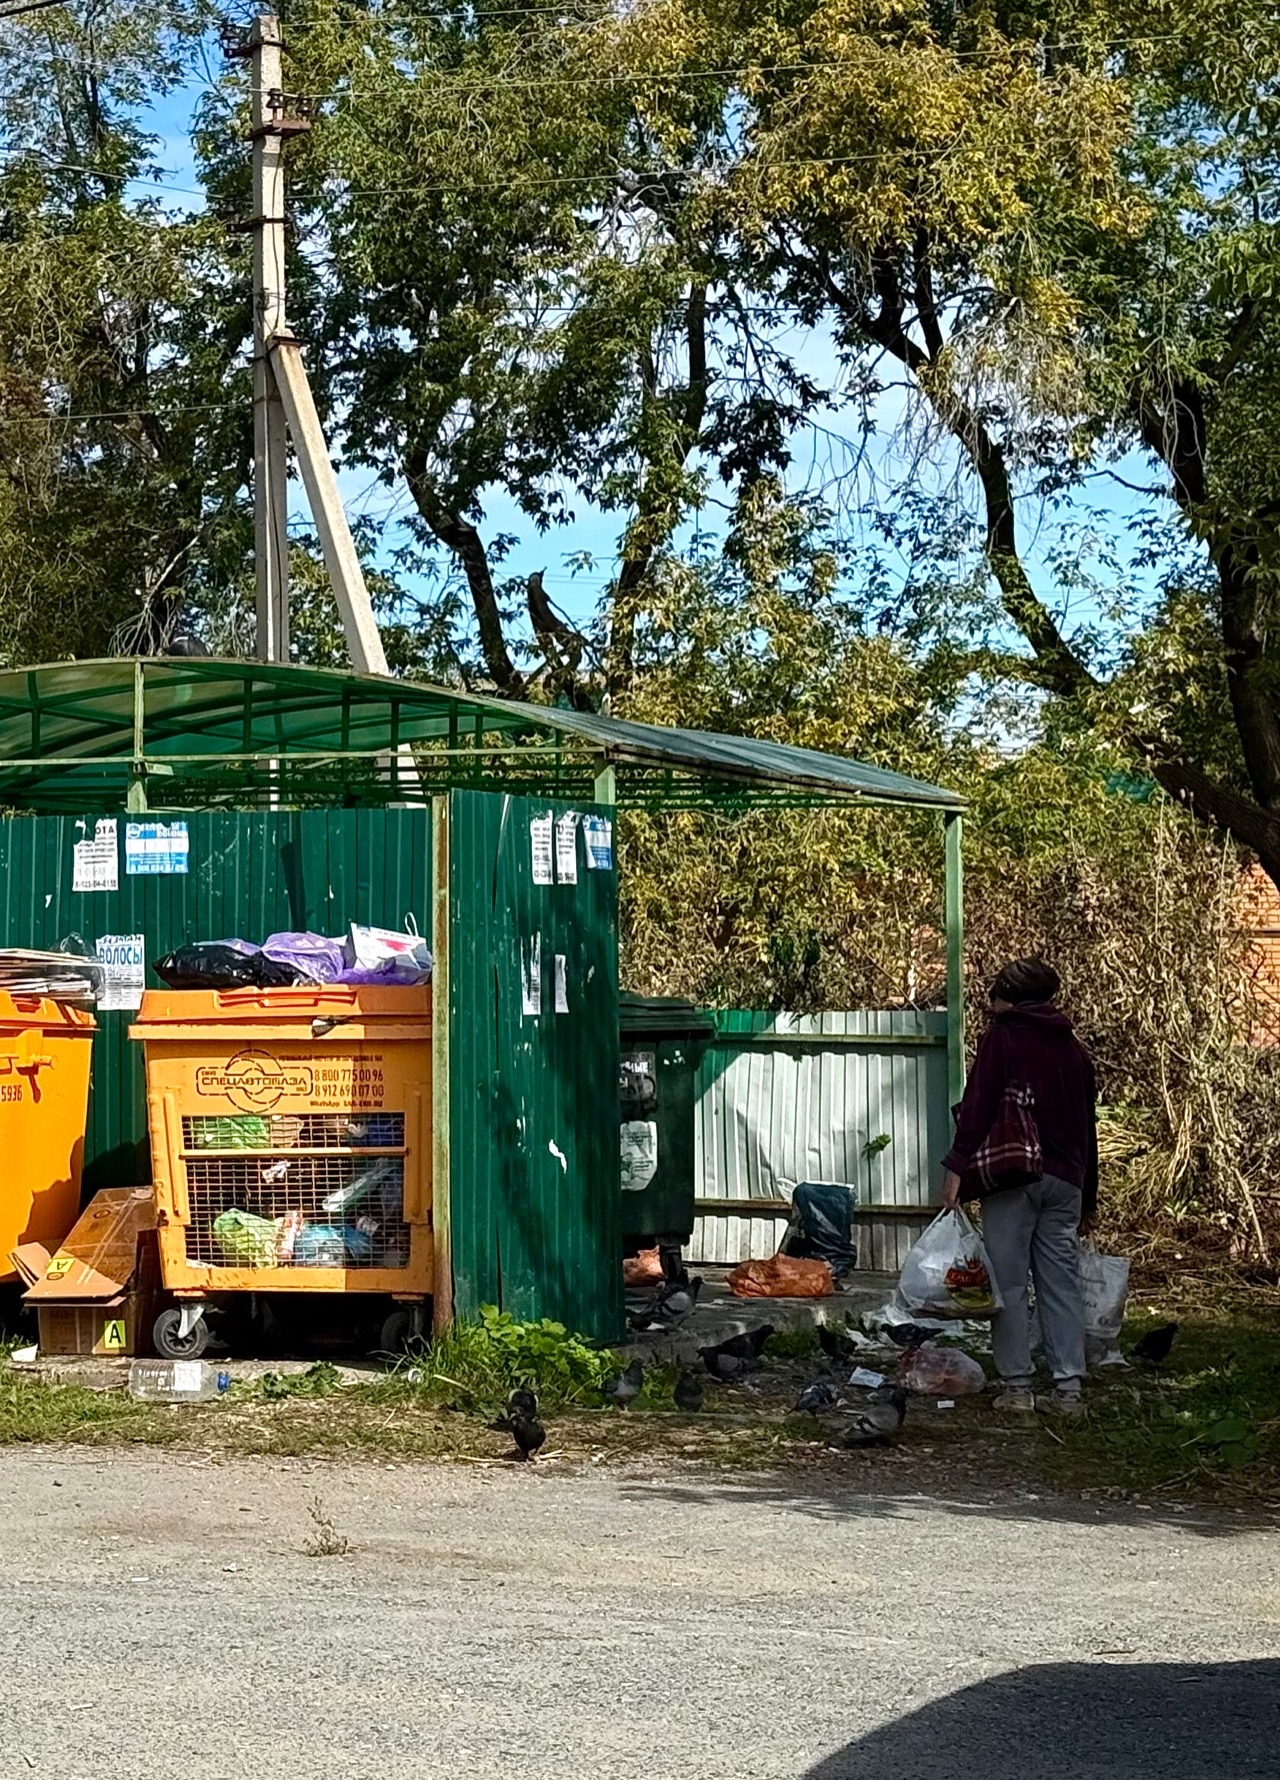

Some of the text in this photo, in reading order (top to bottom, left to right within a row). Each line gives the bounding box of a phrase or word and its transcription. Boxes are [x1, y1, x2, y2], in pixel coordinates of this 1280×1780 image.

[100, 946, 143, 965] ВОЛОСЫ
[314, 1069, 384, 1082] 8 800 775 00 96
[315, 1084, 320, 1097] 8
[322, 1084, 337, 1097] 912
[340, 1084, 356, 1097] 690
[358, 1084, 369, 1097] 07
[372, 1084, 384, 1097] 00
[108, 1323, 123, 1344] A
